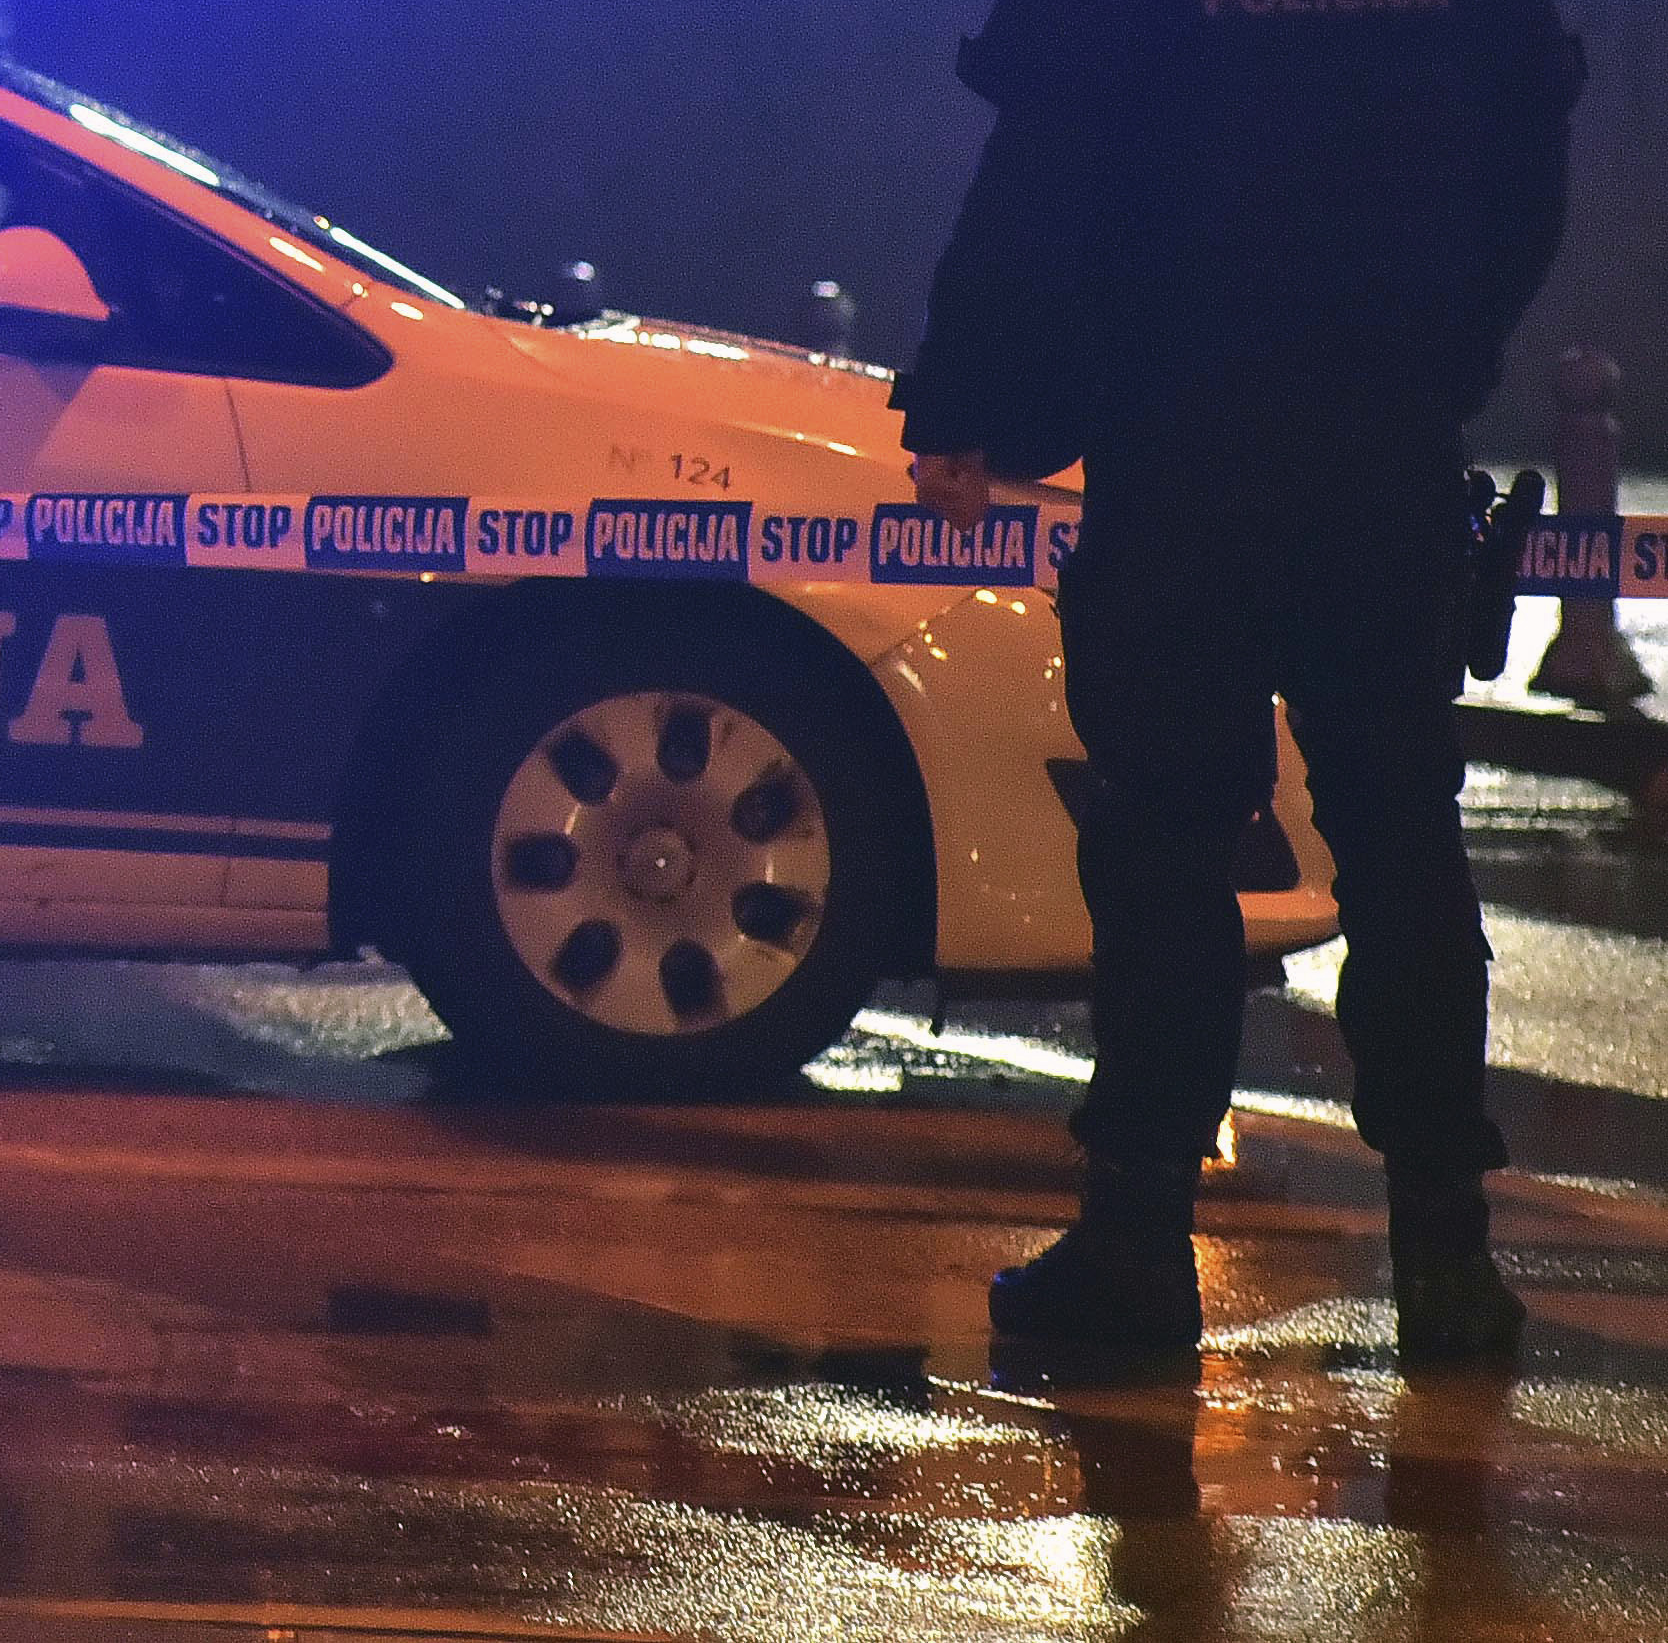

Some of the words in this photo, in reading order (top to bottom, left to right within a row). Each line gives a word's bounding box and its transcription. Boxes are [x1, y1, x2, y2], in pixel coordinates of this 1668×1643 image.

[670, 453, 731, 491] 124
[32, 497, 178, 547] POLICIJA
[197, 503, 292, 549] STOP
[312, 504, 456, 555] POLICIJA
[478, 509, 574, 557] STOP
[593, 511, 740, 561] POLICIJA
[763, 516, 858, 563] STOP
[877, 517, 1027, 567] POLICIJA
